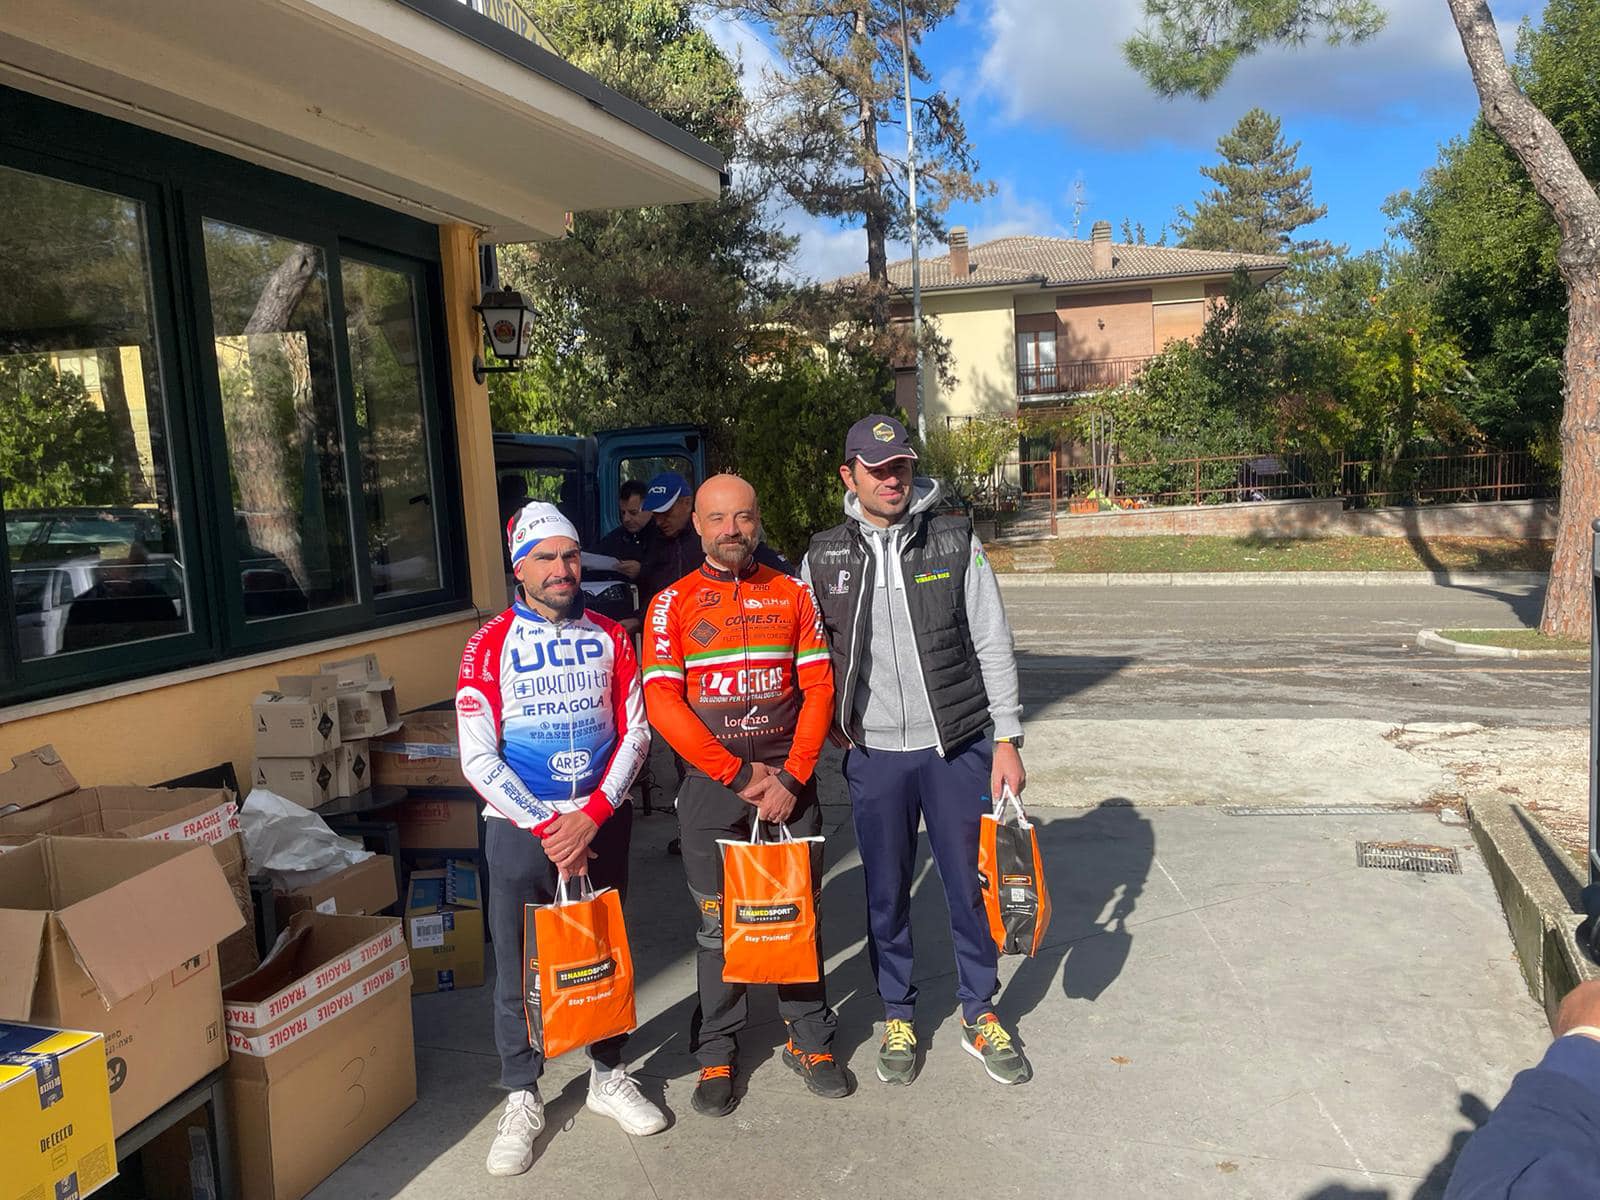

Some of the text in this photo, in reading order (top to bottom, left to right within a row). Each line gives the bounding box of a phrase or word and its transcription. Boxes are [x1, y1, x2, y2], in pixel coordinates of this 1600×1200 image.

[511, 639, 604, 673] UCP
[737, 666, 784, 694] CETEAS
[537, 695, 605, 715] FRAGOLA
[482, 763, 505, 785] UCP
[556, 753, 587, 769] ARES
[182, 811, 222, 838] FRAGILE
[359, 935, 393, 963] FRAGILE
[744, 935, 760, 944] Stay
[315, 959, 353, 990] FRAGILE
[362, 968, 395, 996] FRAGILE
[268, 985, 307, 1018] FRAGILE
[317, 992, 354, 1022] FRAGILE
[568, 998, 585, 1006] Stay
[268, 1017, 309, 1050] FRAGILE
[51, 1123, 74, 1147] CECCO
